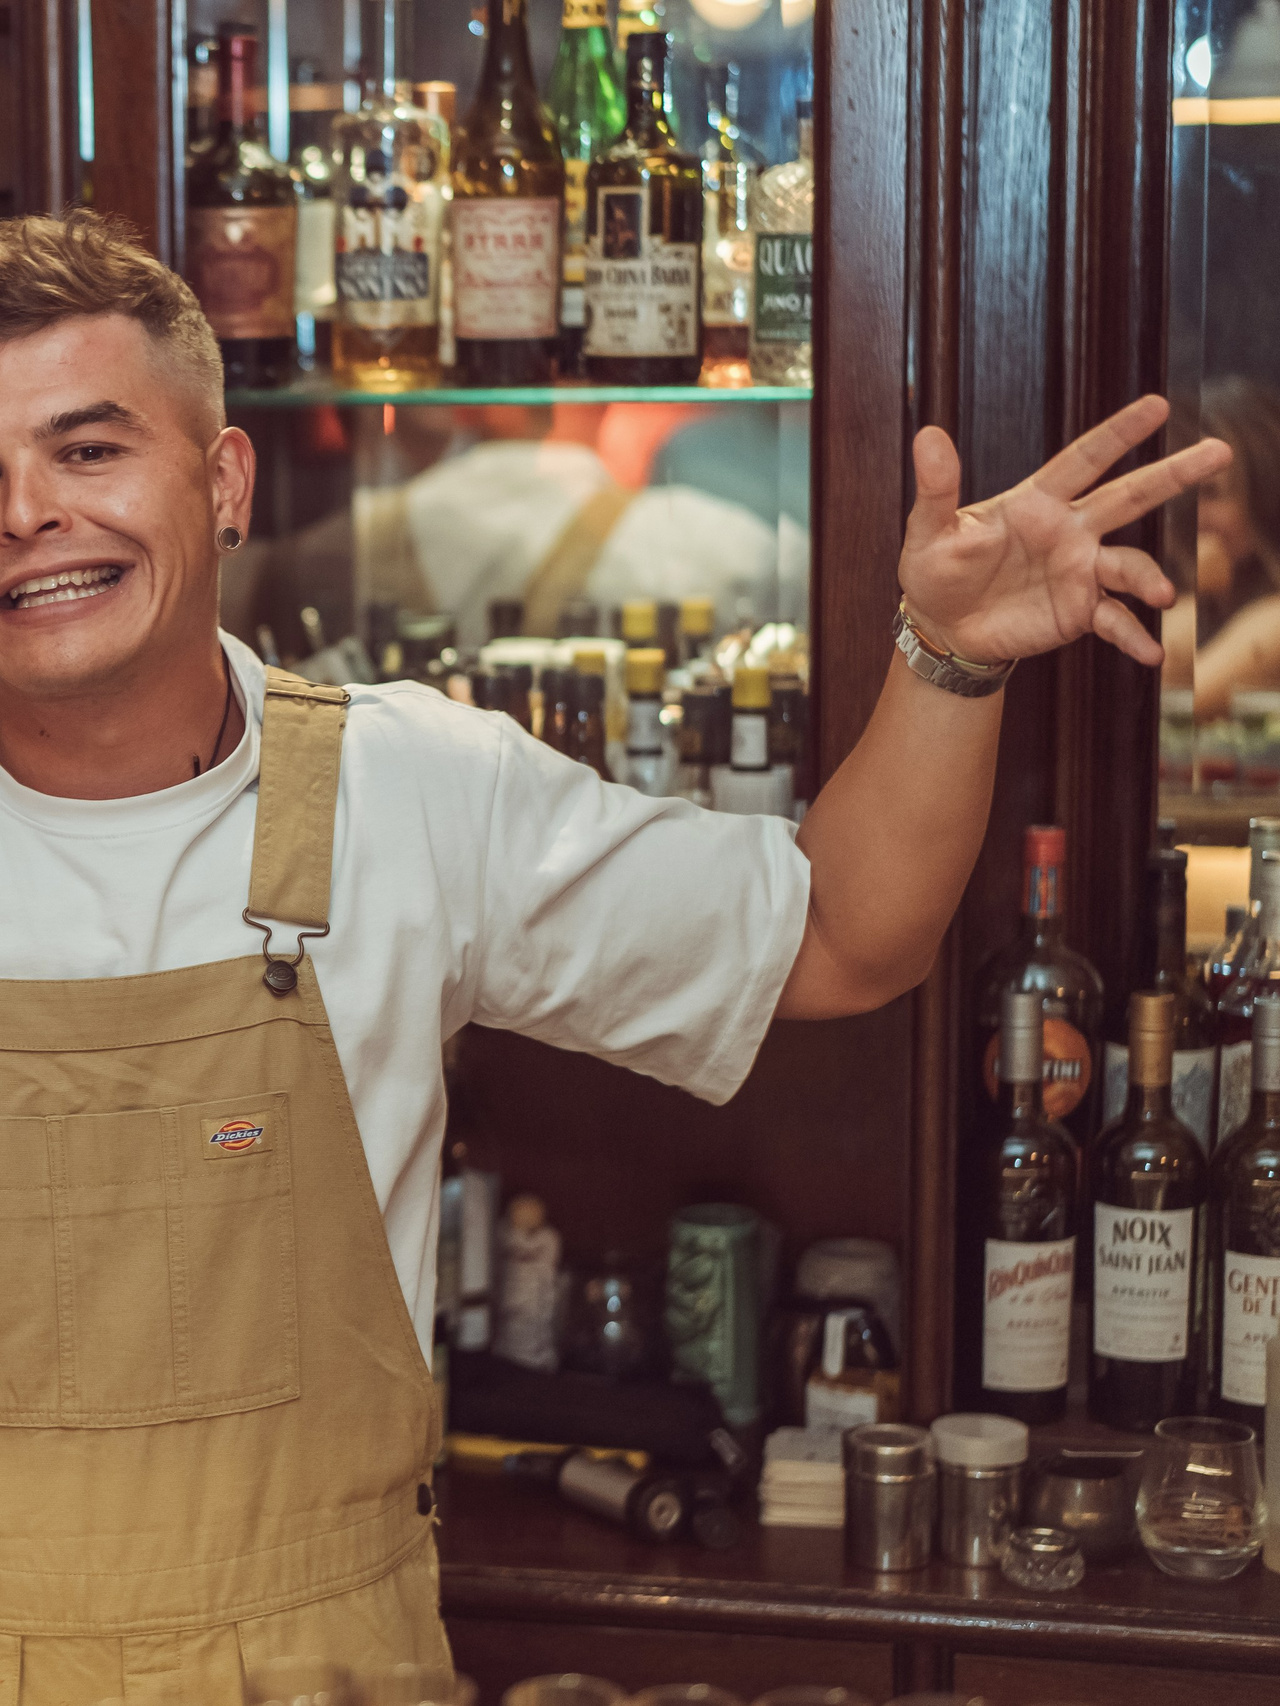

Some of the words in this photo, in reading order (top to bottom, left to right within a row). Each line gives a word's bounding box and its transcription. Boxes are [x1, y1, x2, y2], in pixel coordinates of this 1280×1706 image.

[215, 1129, 261, 1142] Dickies
[1112, 1216, 1172, 1247] NOIX
[1099, 1244, 1142, 1271] SAINT
[1147, 1251, 1186, 1275] JEAN
[1242, 1297, 1263, 1316] DE
